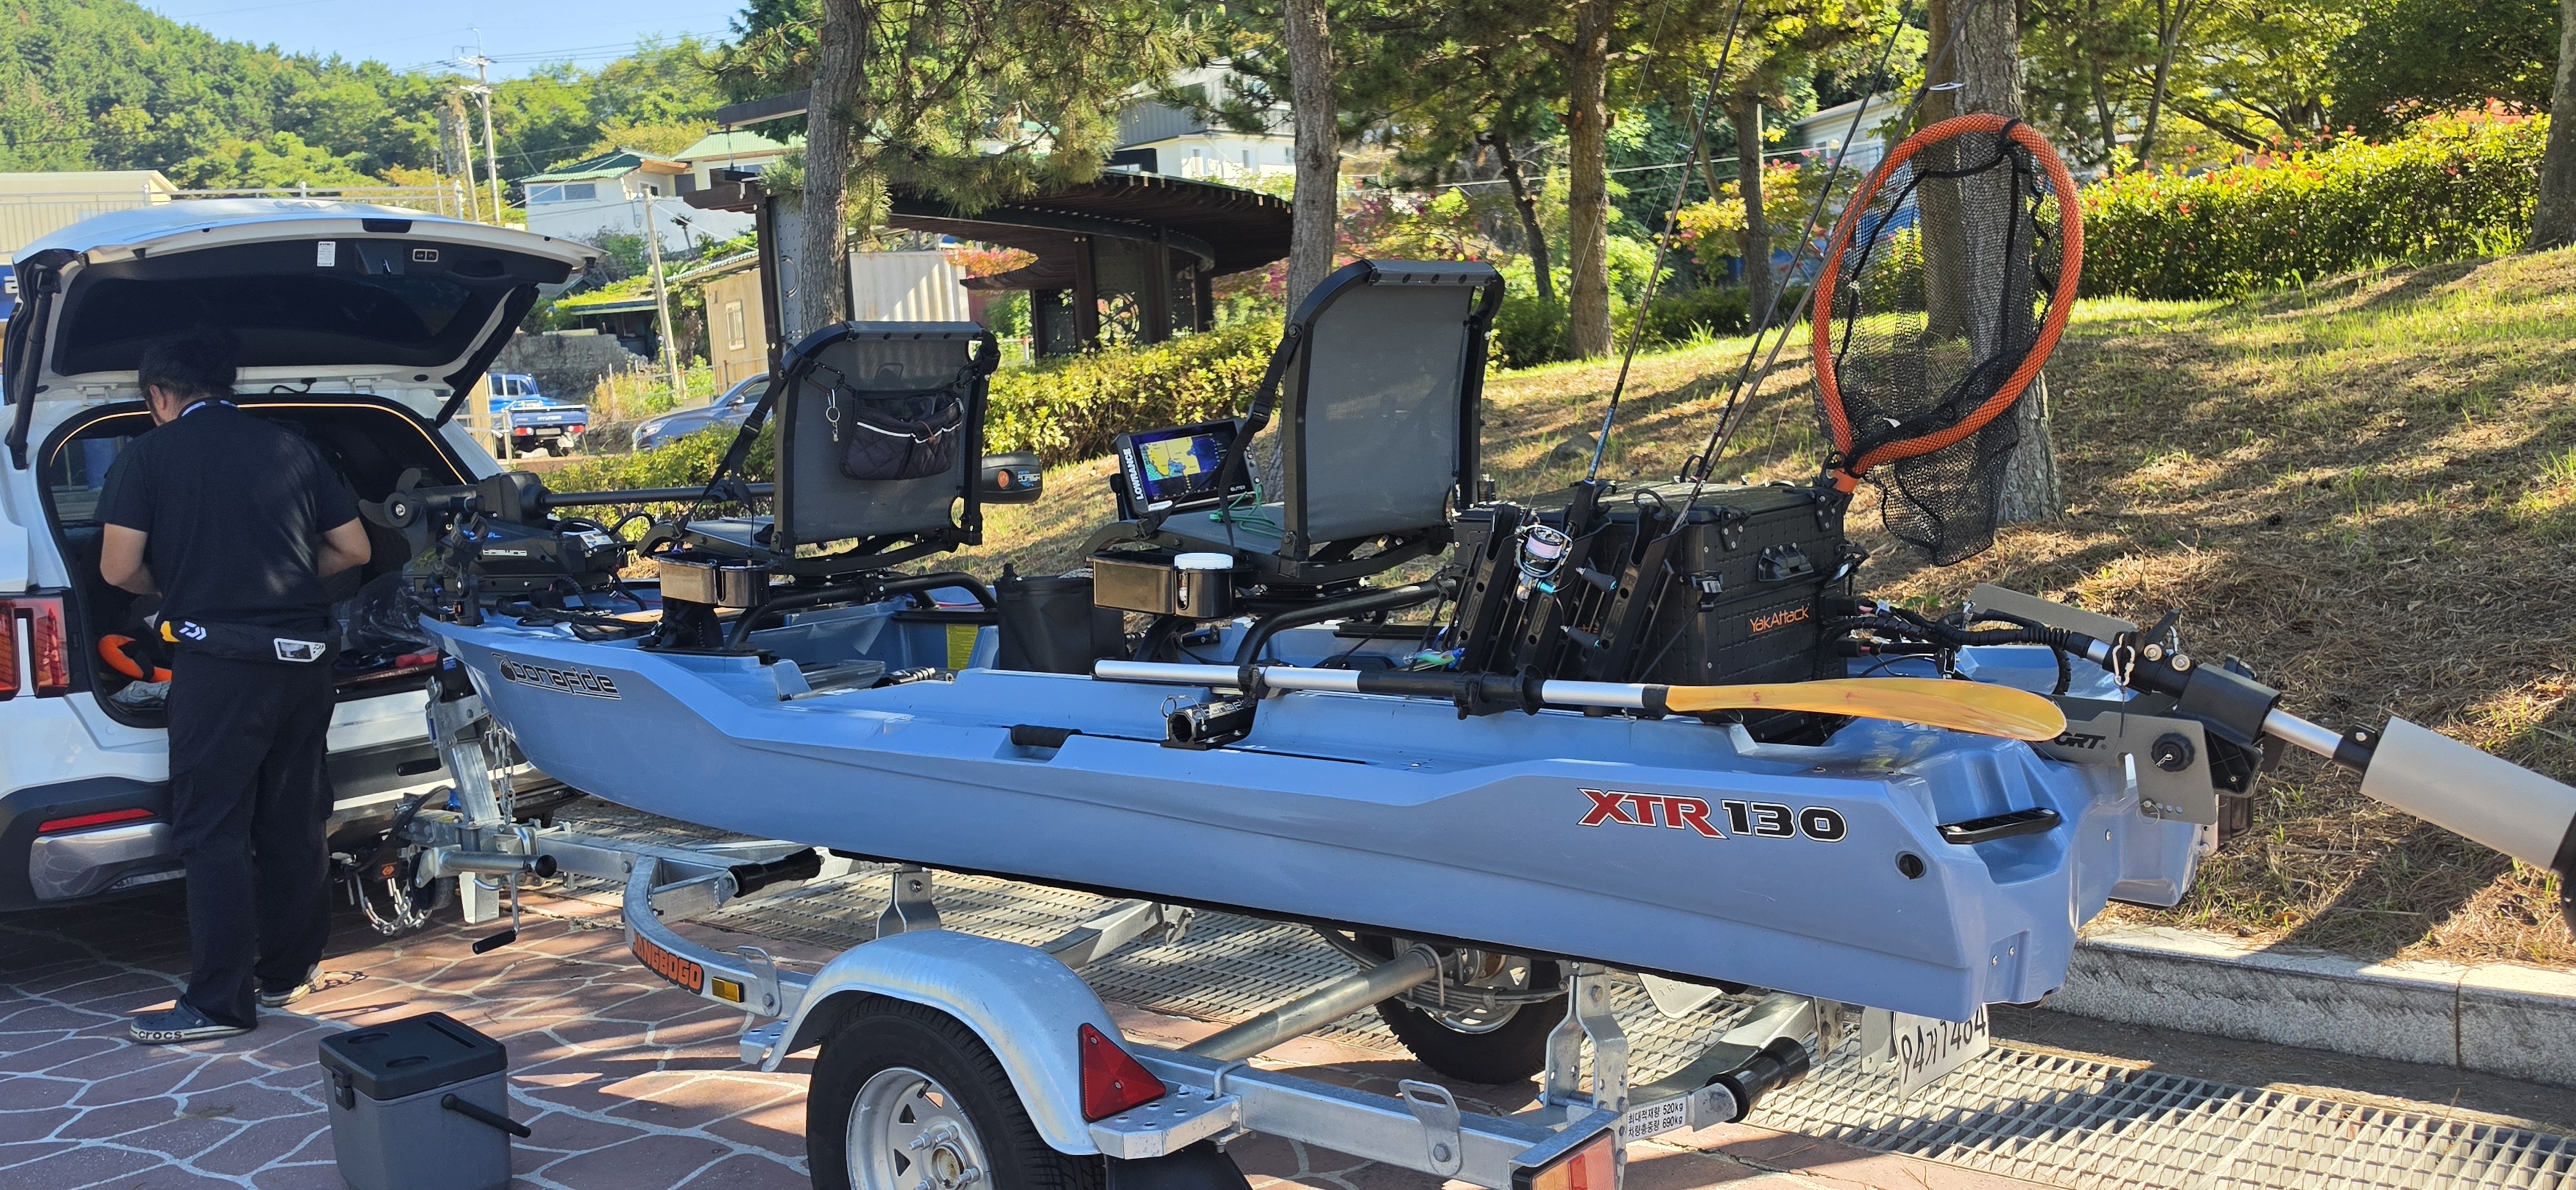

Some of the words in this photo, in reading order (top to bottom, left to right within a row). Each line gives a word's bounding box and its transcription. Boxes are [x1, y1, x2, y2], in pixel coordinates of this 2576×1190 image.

[1123, 448, 1144, 500] LOWRANCE
[1750, 605, 1810, 632] YakAttack
[2053, 732, 2107, 750] ORT
[1577, 788, 1730, 839] XTR
[1721, 798, 1848, 842] 130
[633, 930, 703, 992] JANGBOGO
[138, 1030, 182, 1040] crocs
[1629, 1106, 1660, 1124] 최대적재량
[1662, 1102, 1683, 1115] 520kg
[1628, 1120, 1660, 1137] 차량총중량
[1662, 1115, 1683, 1129] 690kg
